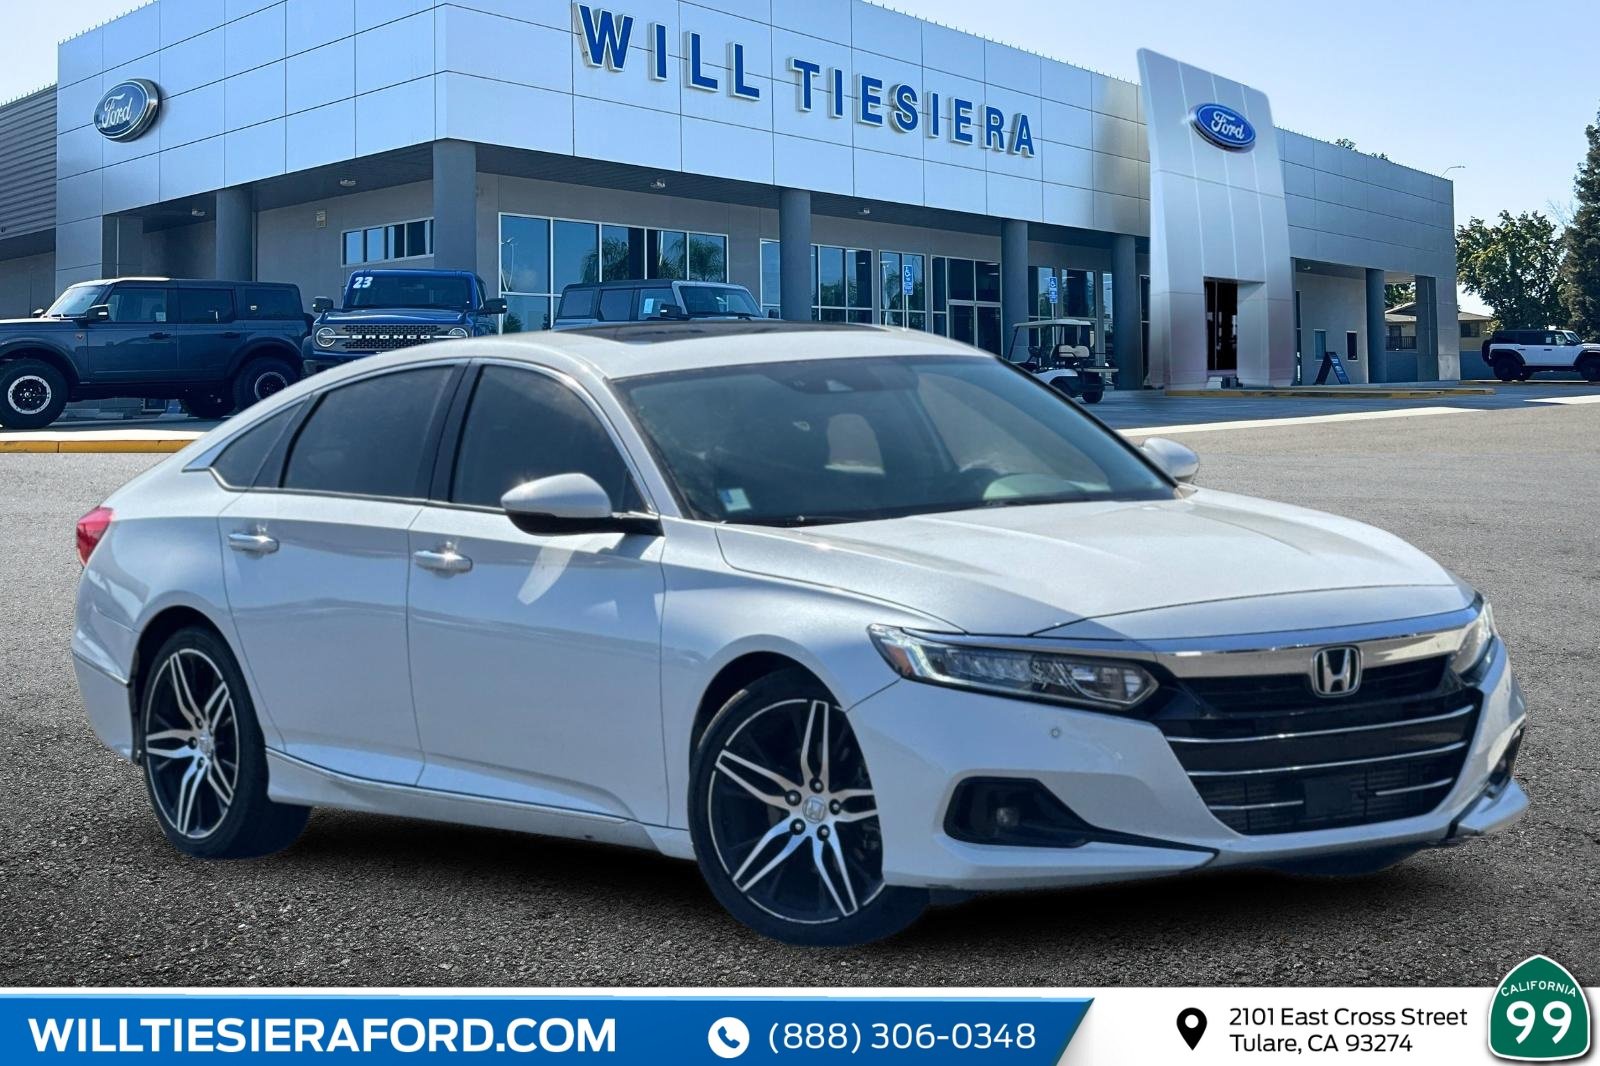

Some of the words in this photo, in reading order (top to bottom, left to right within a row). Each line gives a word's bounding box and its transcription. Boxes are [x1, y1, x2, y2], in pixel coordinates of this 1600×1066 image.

[575, 4, 760, 100] WILL
[789, 57, 1035, 156] TIESIERA
[101, 93, 133, 128] Ford
[1211, 110, 1245, 139] Ford
[352, 276, 374, 289] 23
